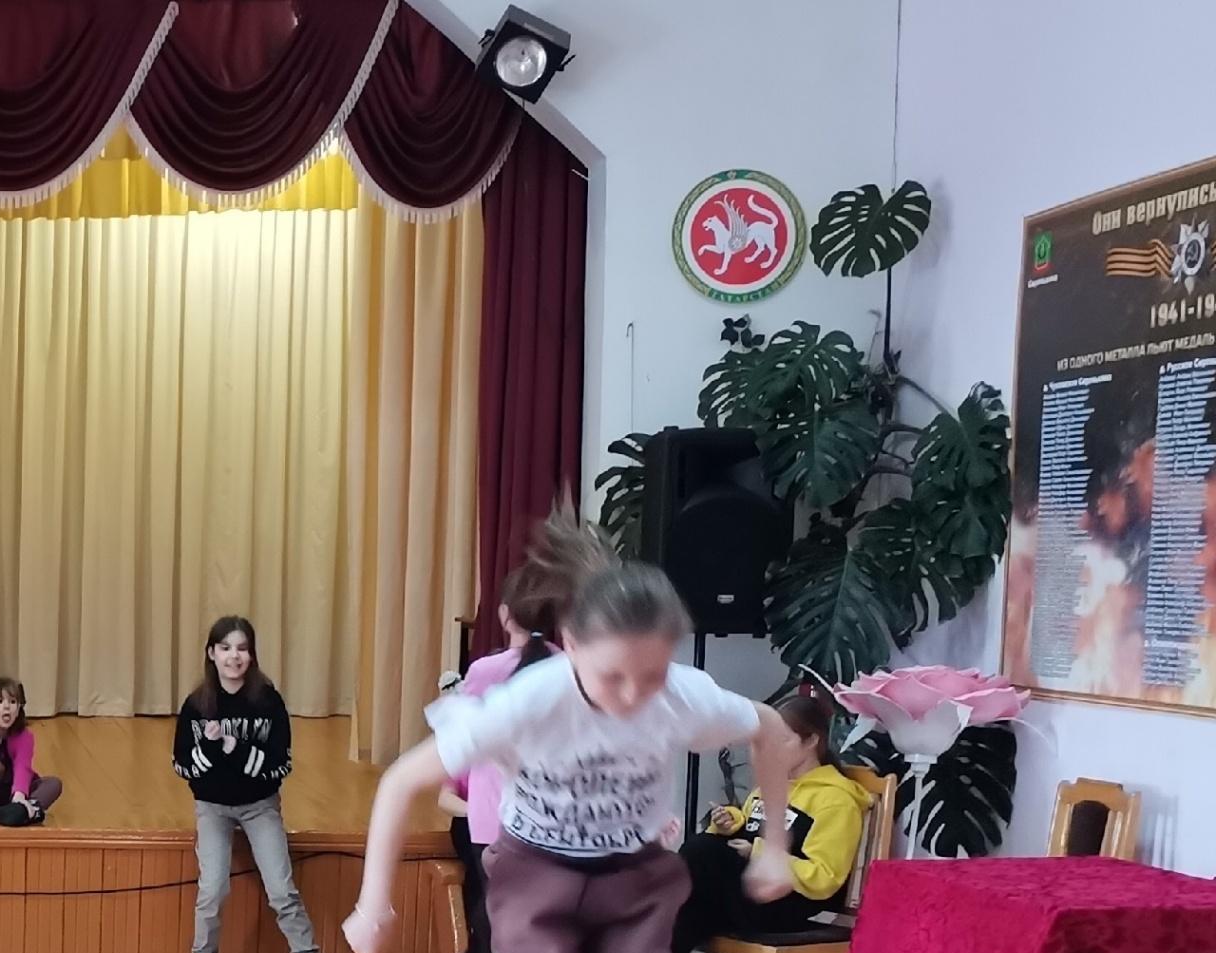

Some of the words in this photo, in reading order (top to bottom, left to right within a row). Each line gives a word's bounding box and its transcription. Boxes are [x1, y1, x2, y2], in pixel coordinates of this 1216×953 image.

[1092, 209, 1121, 235] Они
[1126, 181, 1216, 226] вернулись
[1150, 294, 1216, 328] 1941-19
[1057, 358, 1069, 371] ИЗ
